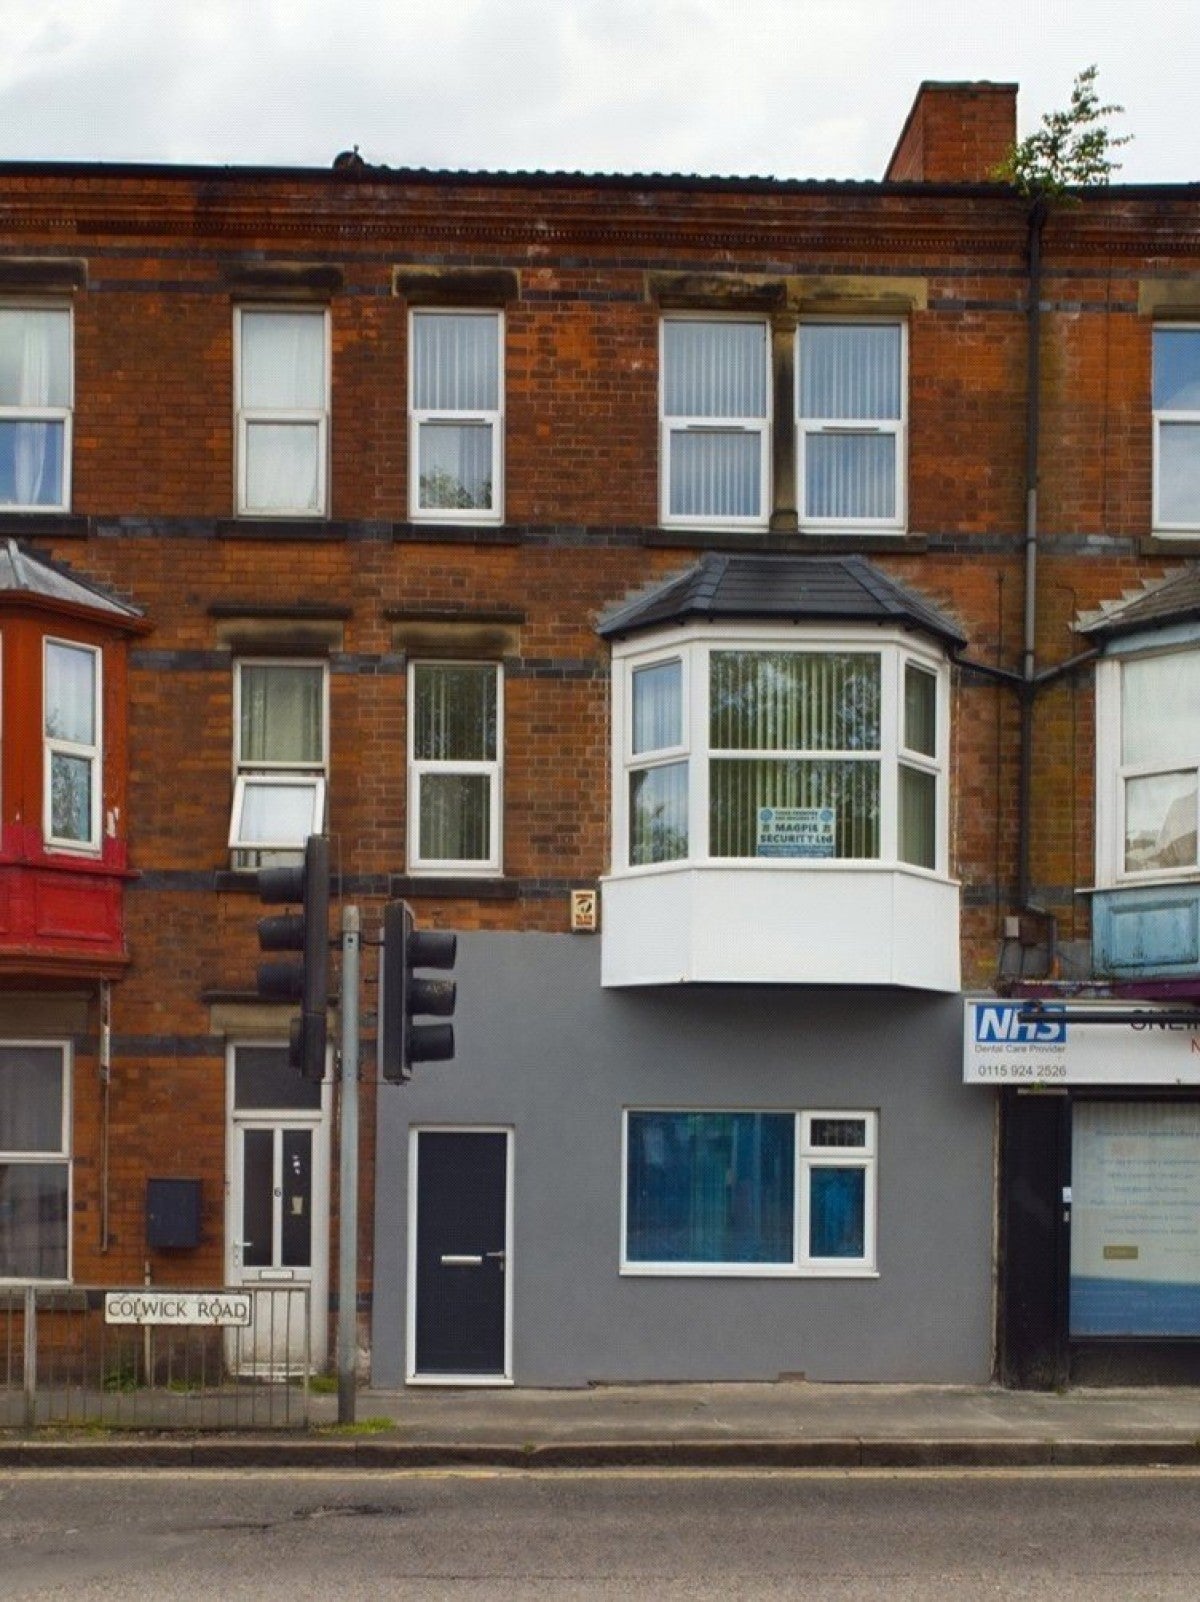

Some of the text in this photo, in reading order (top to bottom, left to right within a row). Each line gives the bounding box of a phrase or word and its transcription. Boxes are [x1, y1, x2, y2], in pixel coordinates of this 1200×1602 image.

[978, 1007, 1061, 1040] NHS
[975, 1045, 1065, 1053] Dental Care Provider
[978, 1065, 1067, 1077] 0115 924 2526
[108, 1301, 247, 1318] COLWICK ROAD
